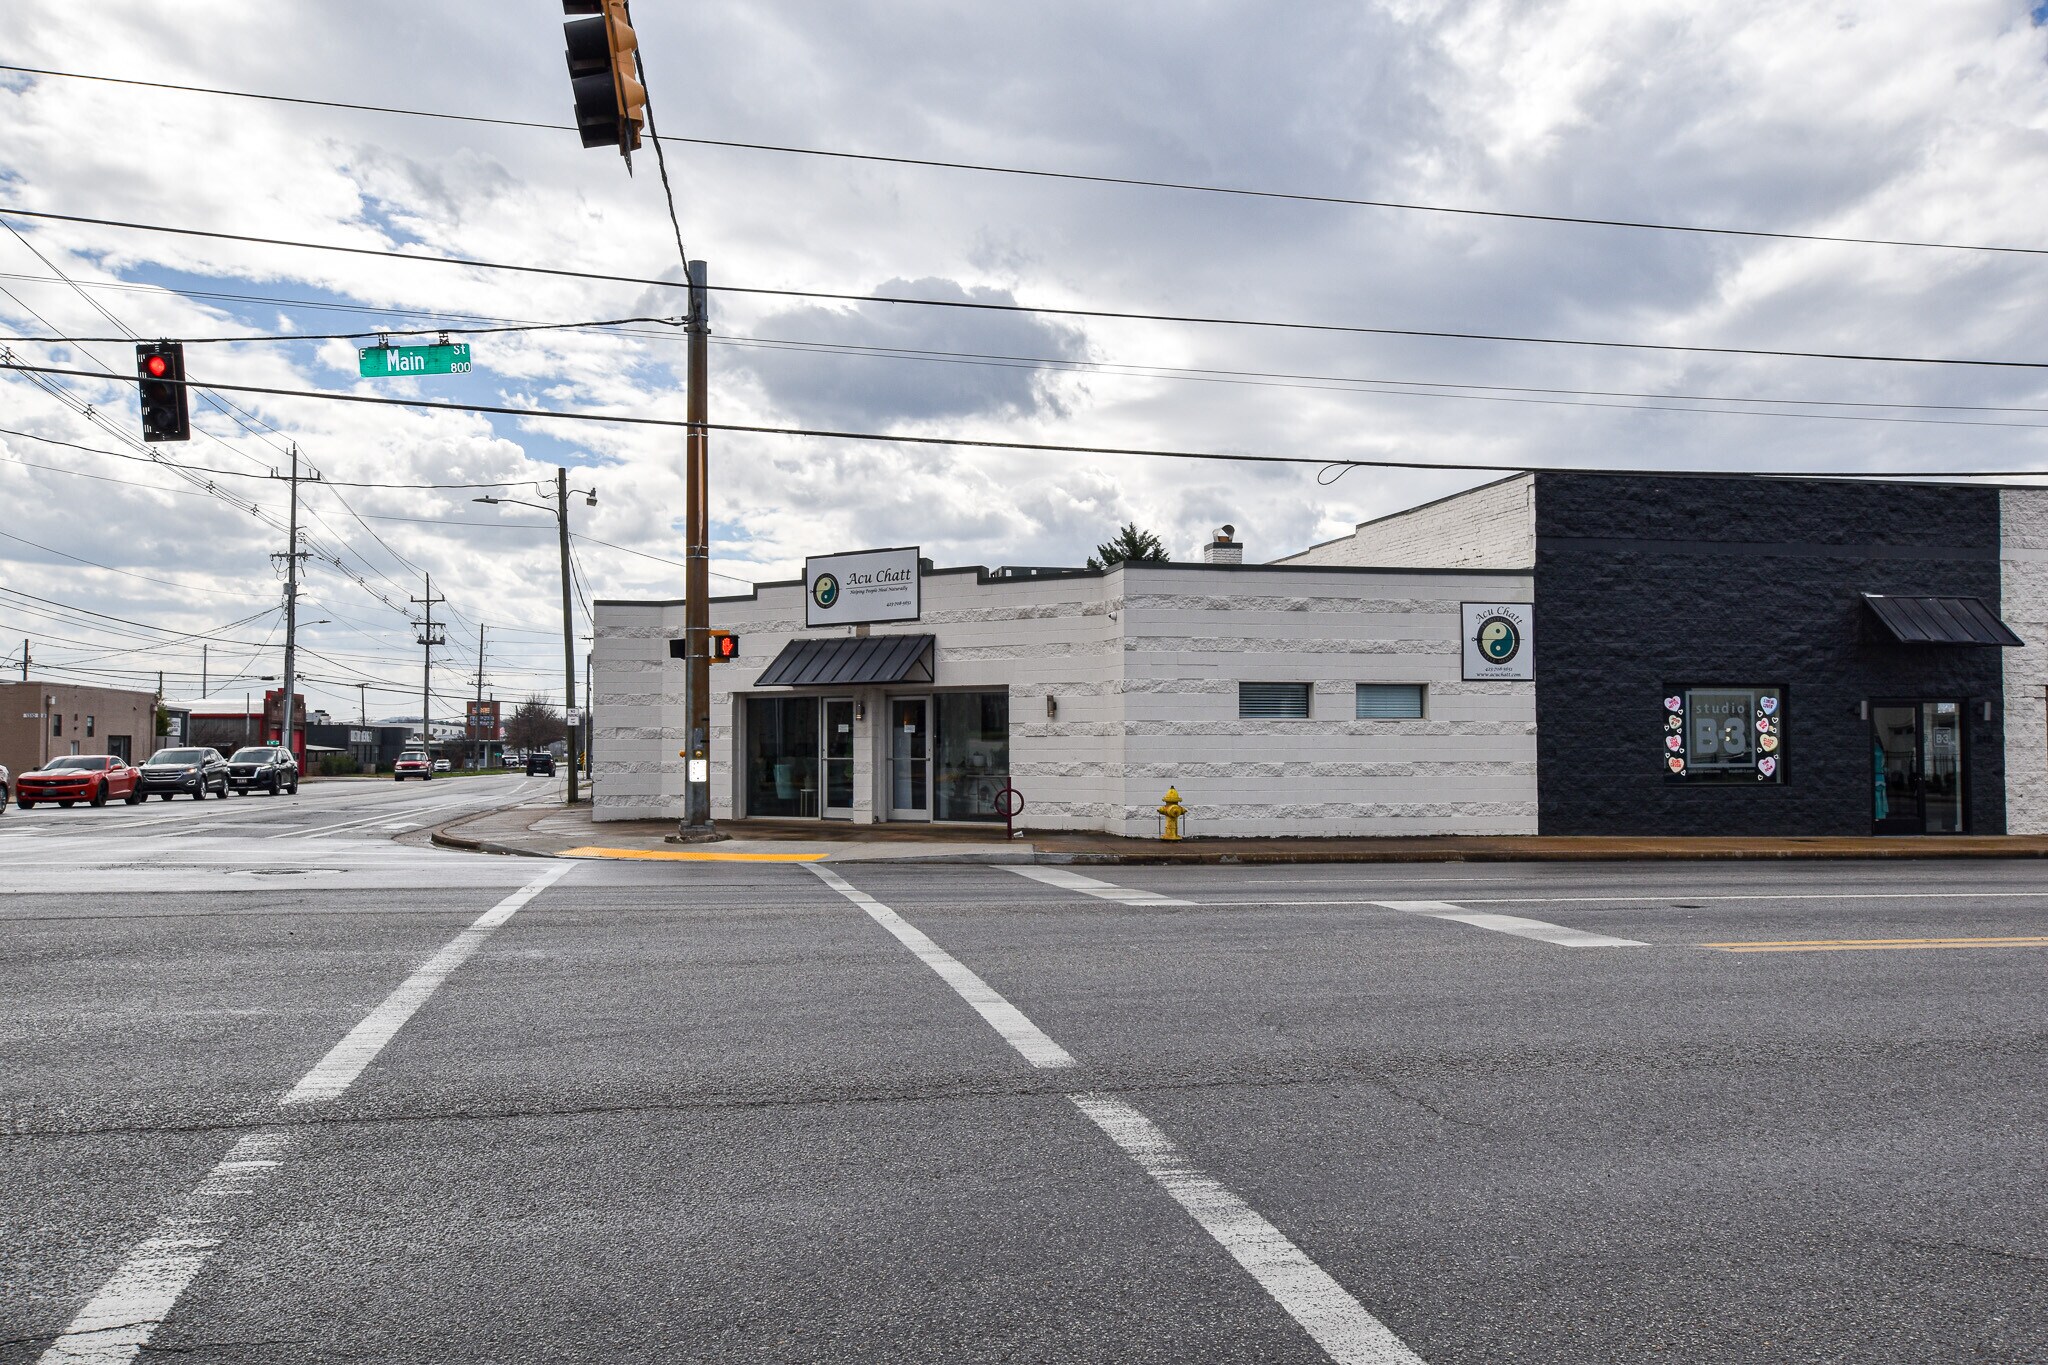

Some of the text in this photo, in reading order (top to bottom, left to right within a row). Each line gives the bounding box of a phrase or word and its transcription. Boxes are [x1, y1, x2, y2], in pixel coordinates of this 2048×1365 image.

[360, 345, 466, 371] E Main St
[450, 362, 471, 373] 800
[846, 568, 911, 585] Acu Chatt
[1476, 606, 1523, 625] Acu Chatt
[1695, 702, 1745, 714] studio
